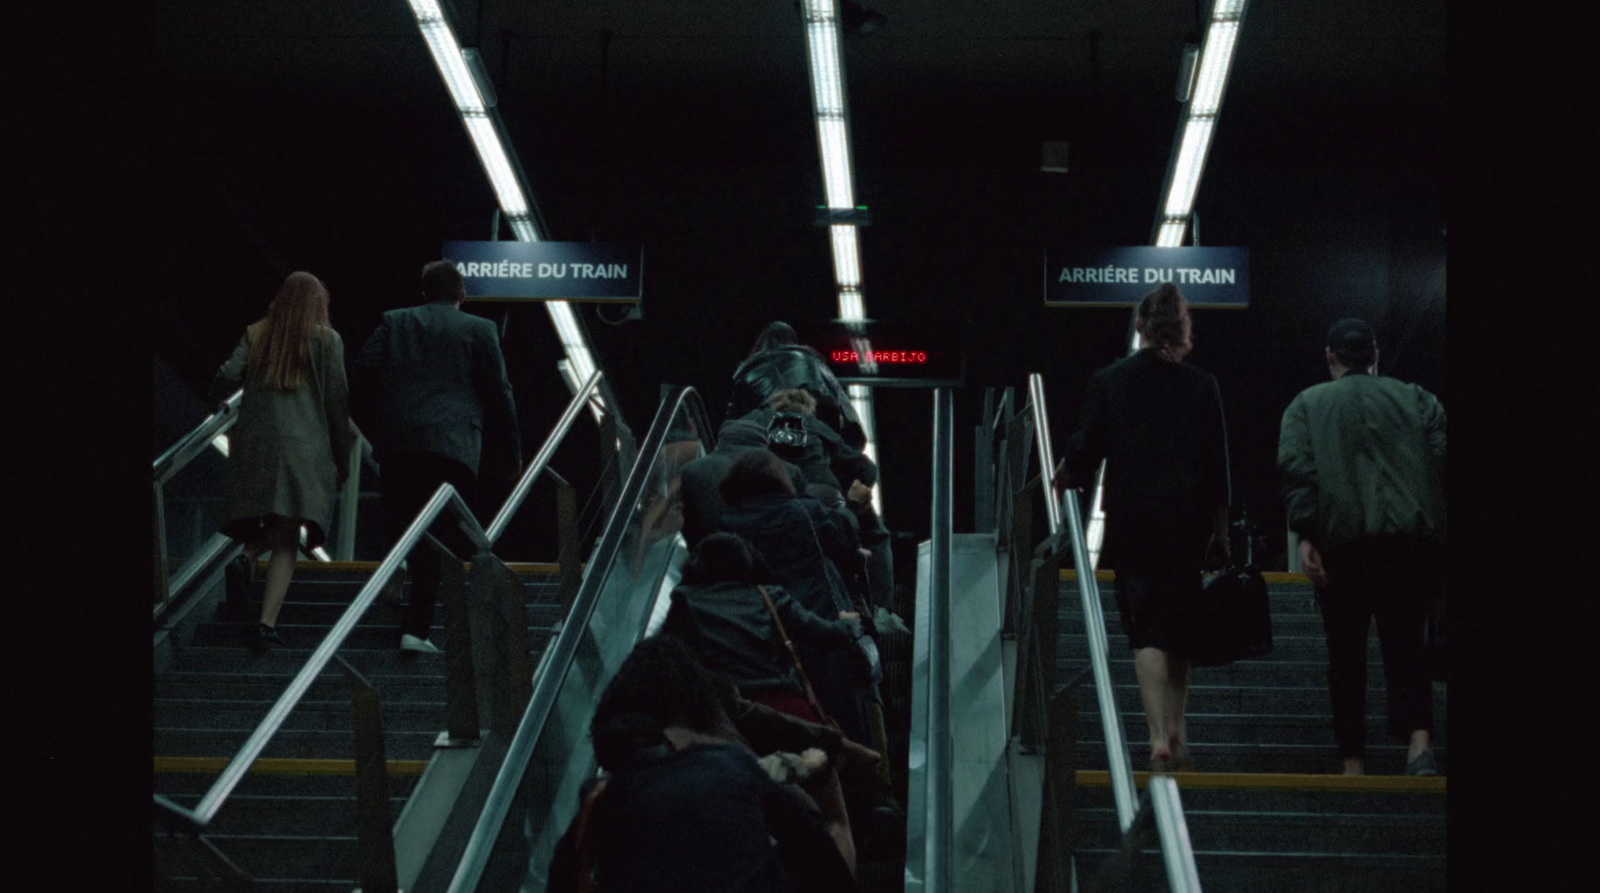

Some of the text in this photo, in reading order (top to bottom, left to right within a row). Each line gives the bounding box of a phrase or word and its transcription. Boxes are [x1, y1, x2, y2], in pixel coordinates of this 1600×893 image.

[538, 263, 566, 278] DU
[570, 263, 628, 279] TRAIN
[1059, 264, 1236, 284] ARRIÉRE DU TRAIN
[832, 351, 927, 363] USA BARBIJO
